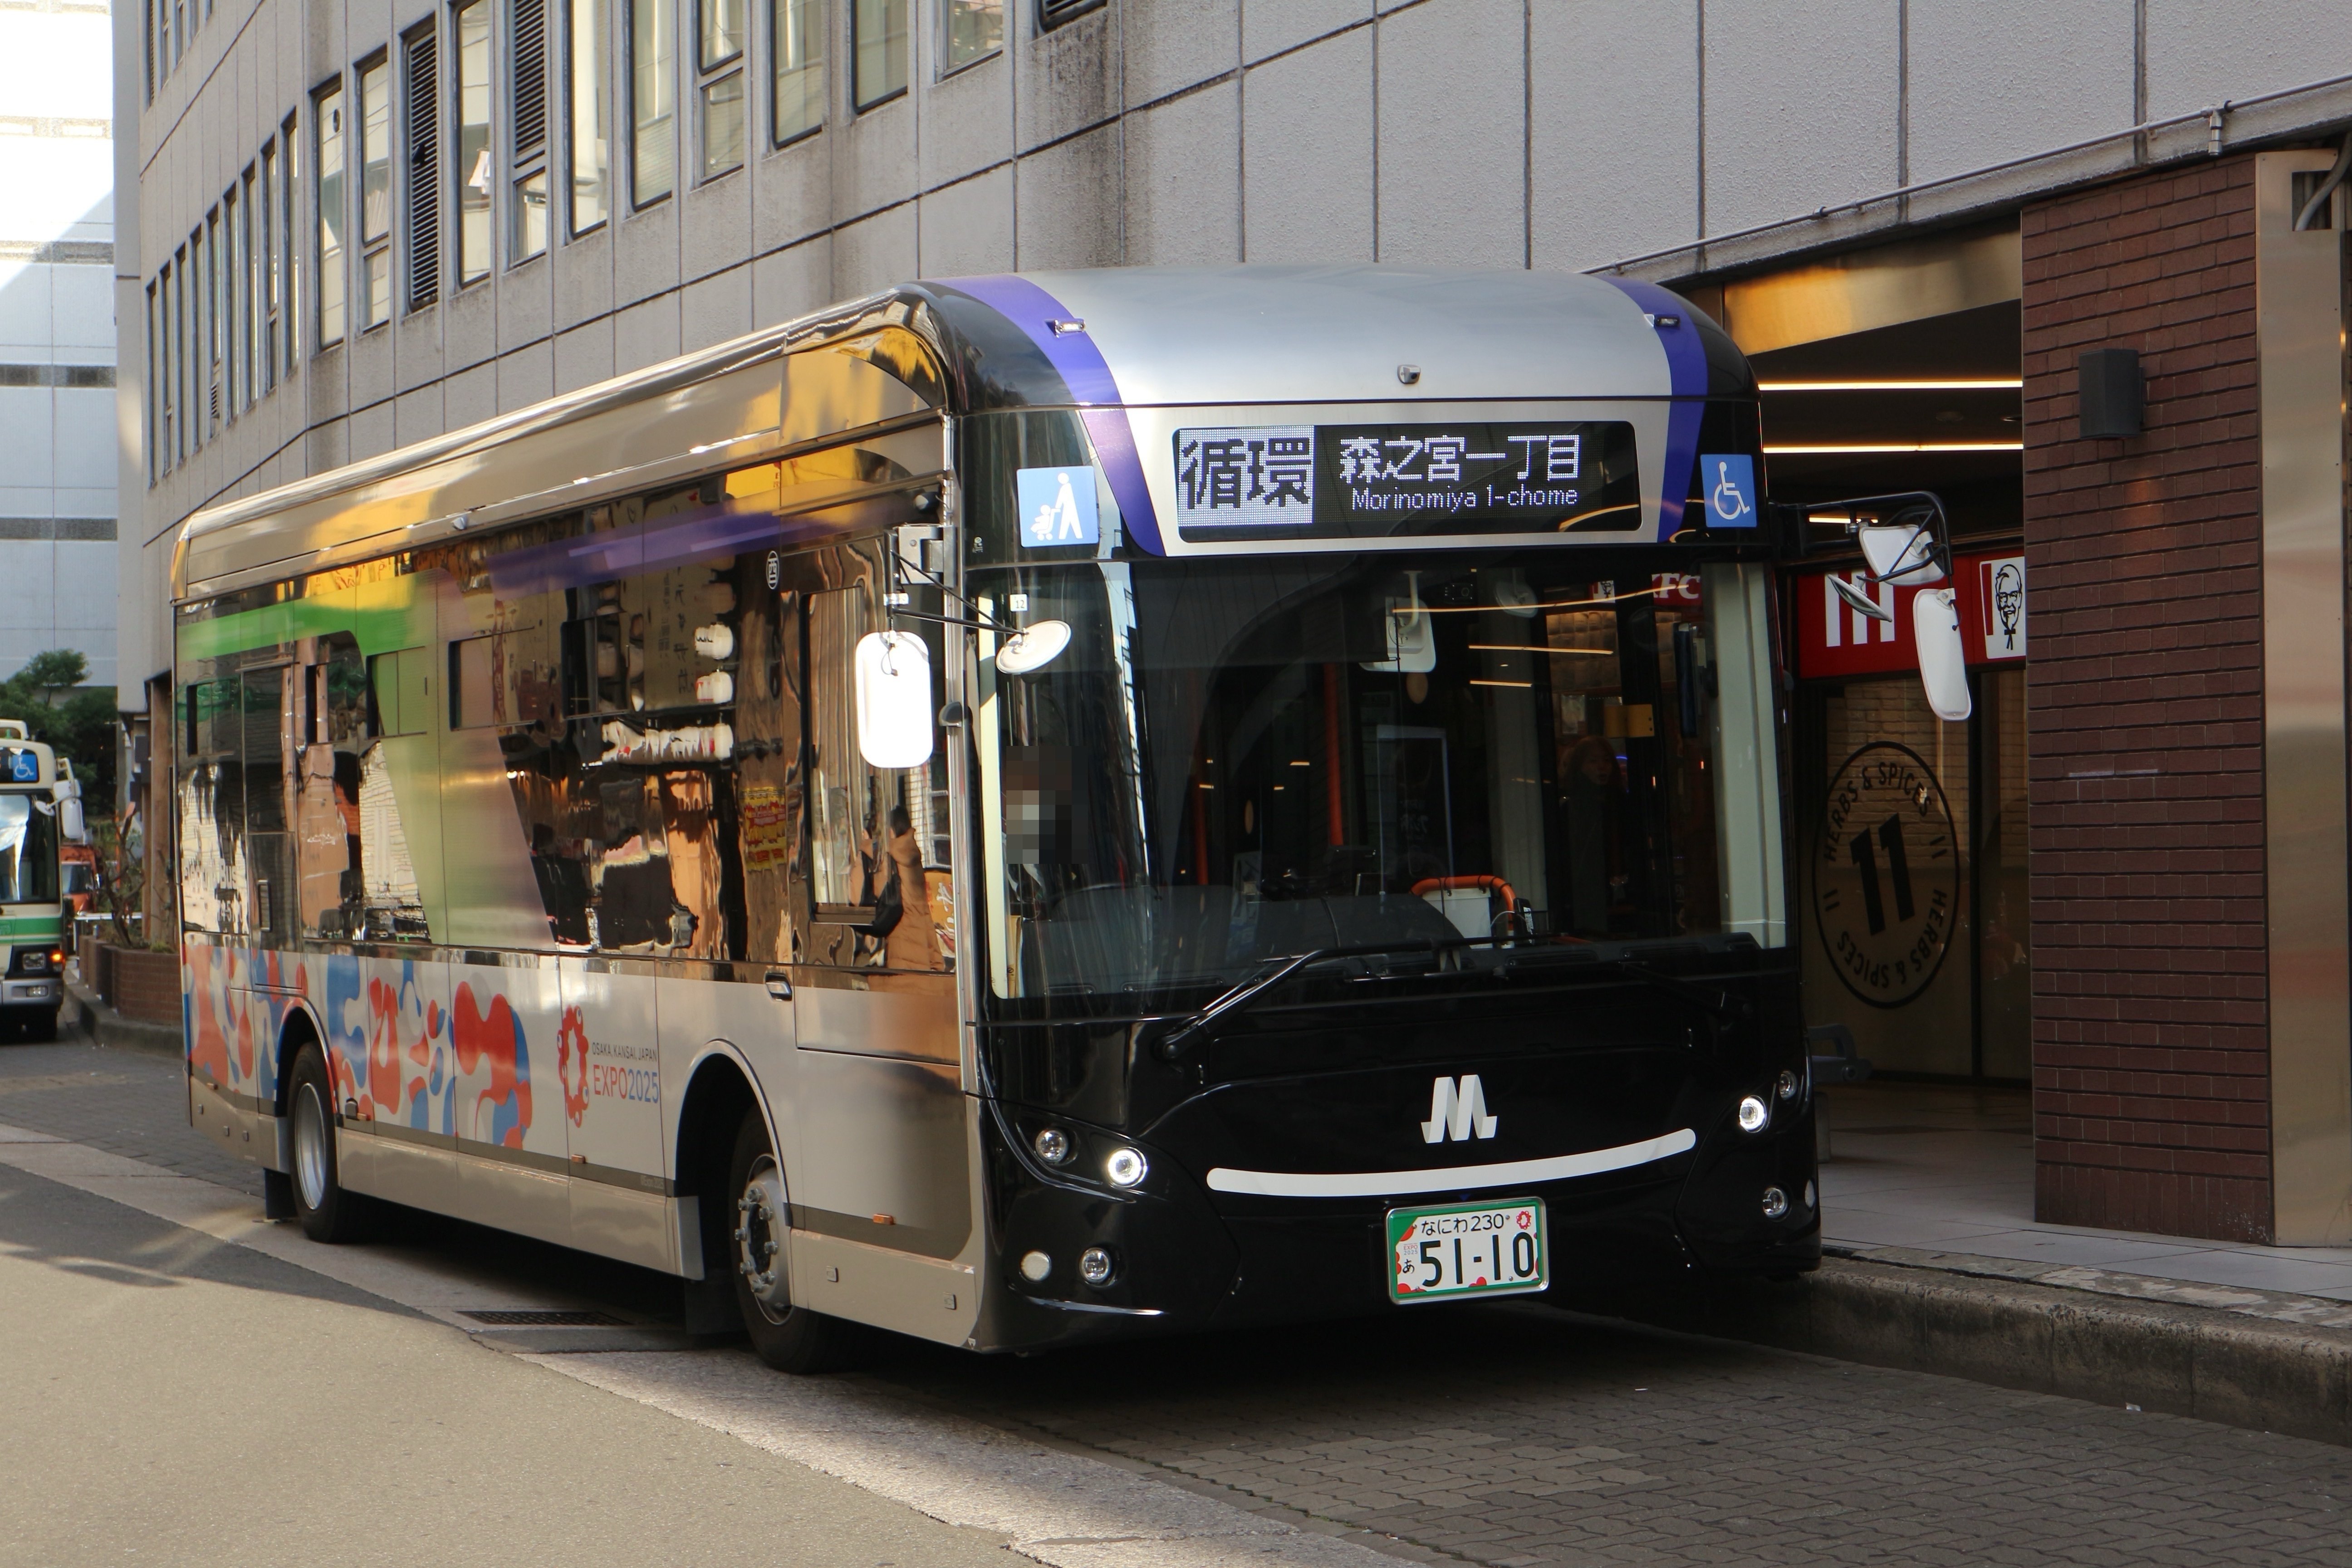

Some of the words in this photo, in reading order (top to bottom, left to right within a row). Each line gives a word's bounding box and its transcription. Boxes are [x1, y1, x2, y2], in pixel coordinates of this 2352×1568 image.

[1180, 437, 1313, 511] 循環
[1338, 434, 1581, 485] 森之宮一丁目
[1351, 487, 1477, 513] Morinomiya
[1486, 484, 1578, 509] 1-chome
[1015, 599, 1025, 608] 12
[1824, 780, 1858, 861] HERBS
[1862, 767, 1872, 790] &
[1878, 761, 1932, 817] SPICES
[1849, 812, 1916, 936] 11
[1910, 889, 1947, 972] HERBS
[1837, 931, 1889, 988] SPICES
[1895, 960, 1907, 985] &
[638, 1048, 657, 1062] JAPAN
[1402, 1259, 1415, 1274] あ
[1419, 1231, 1534, 1287] 51-10
